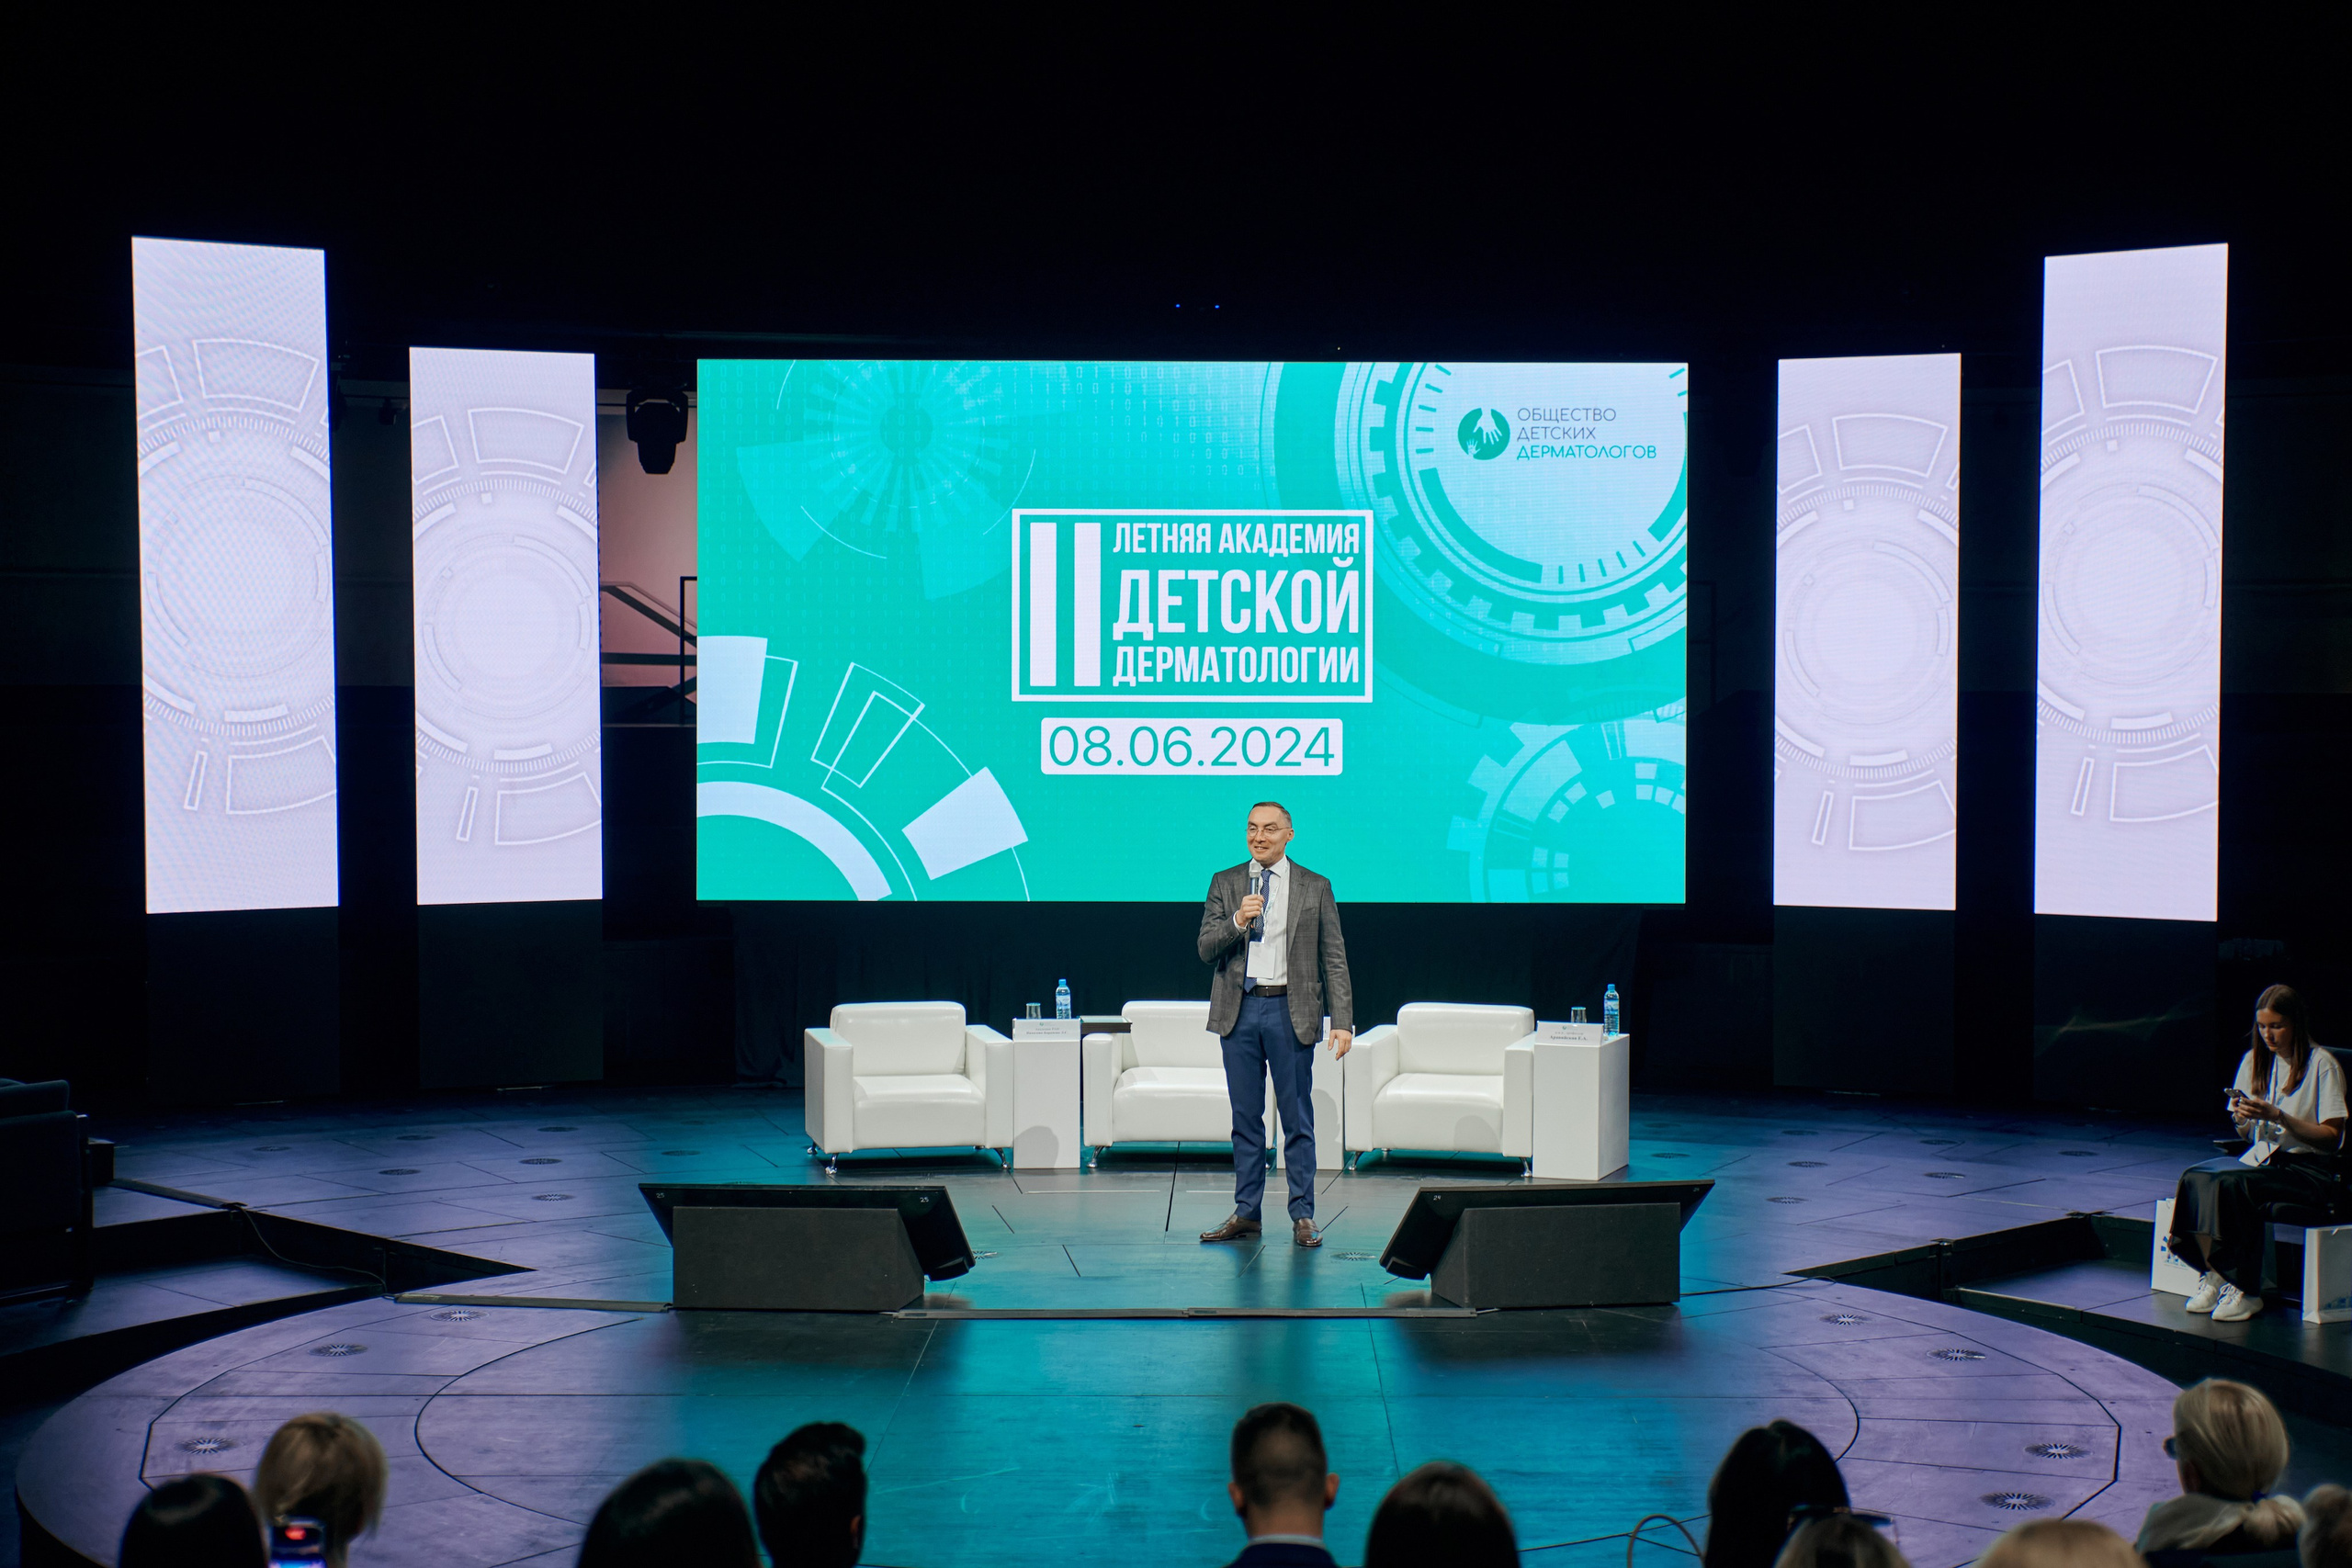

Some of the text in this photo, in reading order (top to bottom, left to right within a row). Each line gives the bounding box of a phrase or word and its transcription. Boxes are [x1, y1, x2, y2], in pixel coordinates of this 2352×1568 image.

[1517, 407, 1617, 423] ОБЩЕСТВО
[1517, 426, 1596, 442] ДЕТСКИХ
[1517, 445, 1657, 461] ДЕРМАТОЛОГОВ
[1113, 522, 1360, 558] ЛЕТНЯЯ АКАДЕМИЯ
[1030, 522, 1101, 687] II
[1113, 557, 1360, 640] ДЕТСКОЙ
[1113, 646, 1359, 687] ДЕРМАТОЛОГИИ
[1048, 725, 1335, 768] 08.06.2024
